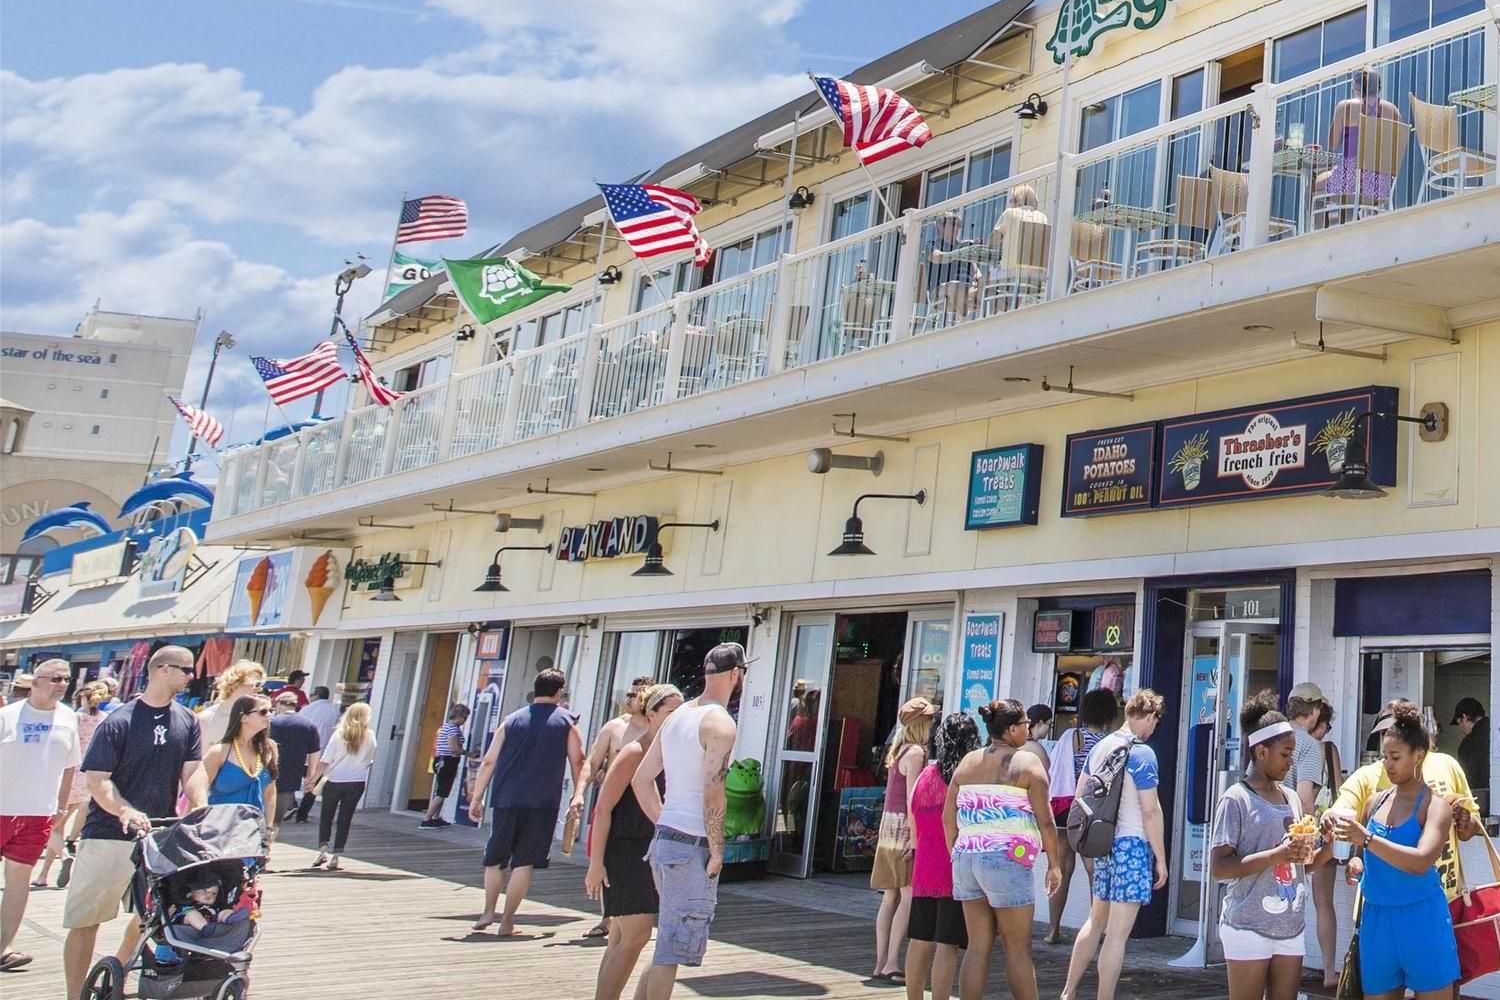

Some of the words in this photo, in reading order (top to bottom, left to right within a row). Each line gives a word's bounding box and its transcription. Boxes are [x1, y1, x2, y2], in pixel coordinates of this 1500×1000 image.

[1, 347, 29, 358] star
[32, 349, 48, 360] of
[52, 350, 74, 362] the
[76, 354, 101, 364] sea
[1224, 430, 1301, 455] Thrasher's
[1093, 443, 1128, 461] IDAHO
[1083, 458, 1136, 480] POTATOES
[1224, 454, 1263, 472] french
[1269, 451, 1298, 467] fries
[1089, 480, 1114, 489] COOKED
[1093, 486, 1128, 503] PEANUT
[1130, 485, 1144, 499] OIL
[557, 515, 649, 561] PLAYLAND
[1242, 600, 1260, 616] 101
